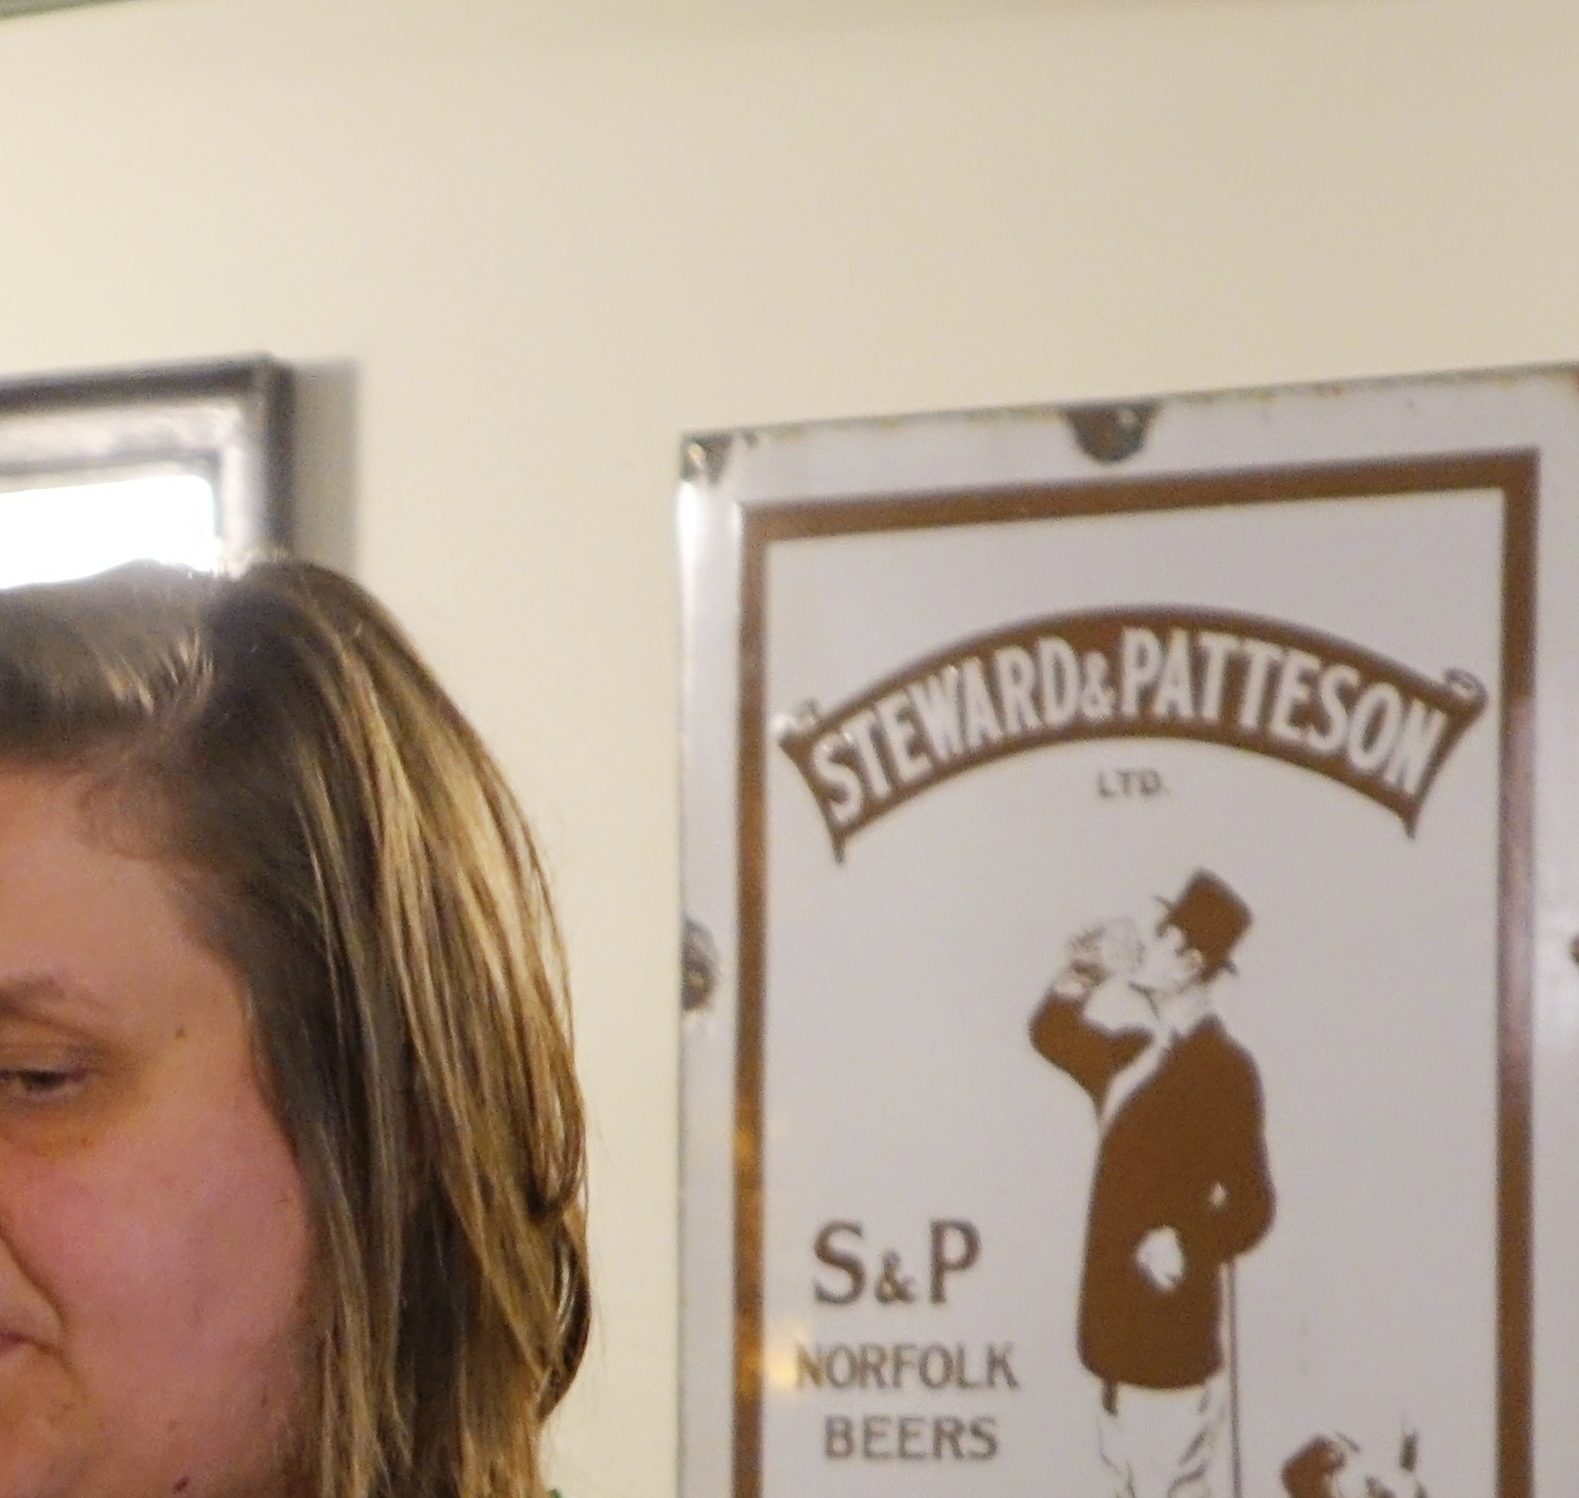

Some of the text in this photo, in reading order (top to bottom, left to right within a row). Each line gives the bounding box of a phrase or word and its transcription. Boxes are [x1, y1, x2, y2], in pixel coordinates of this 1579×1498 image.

[811, 636, 1079, 830] STEWARD
[1120, 626, 1445, 800] PATTESON
[795, 1342, 1019, 1391] NORFOLK
[824, 1416, 999, 1461] BEERS
